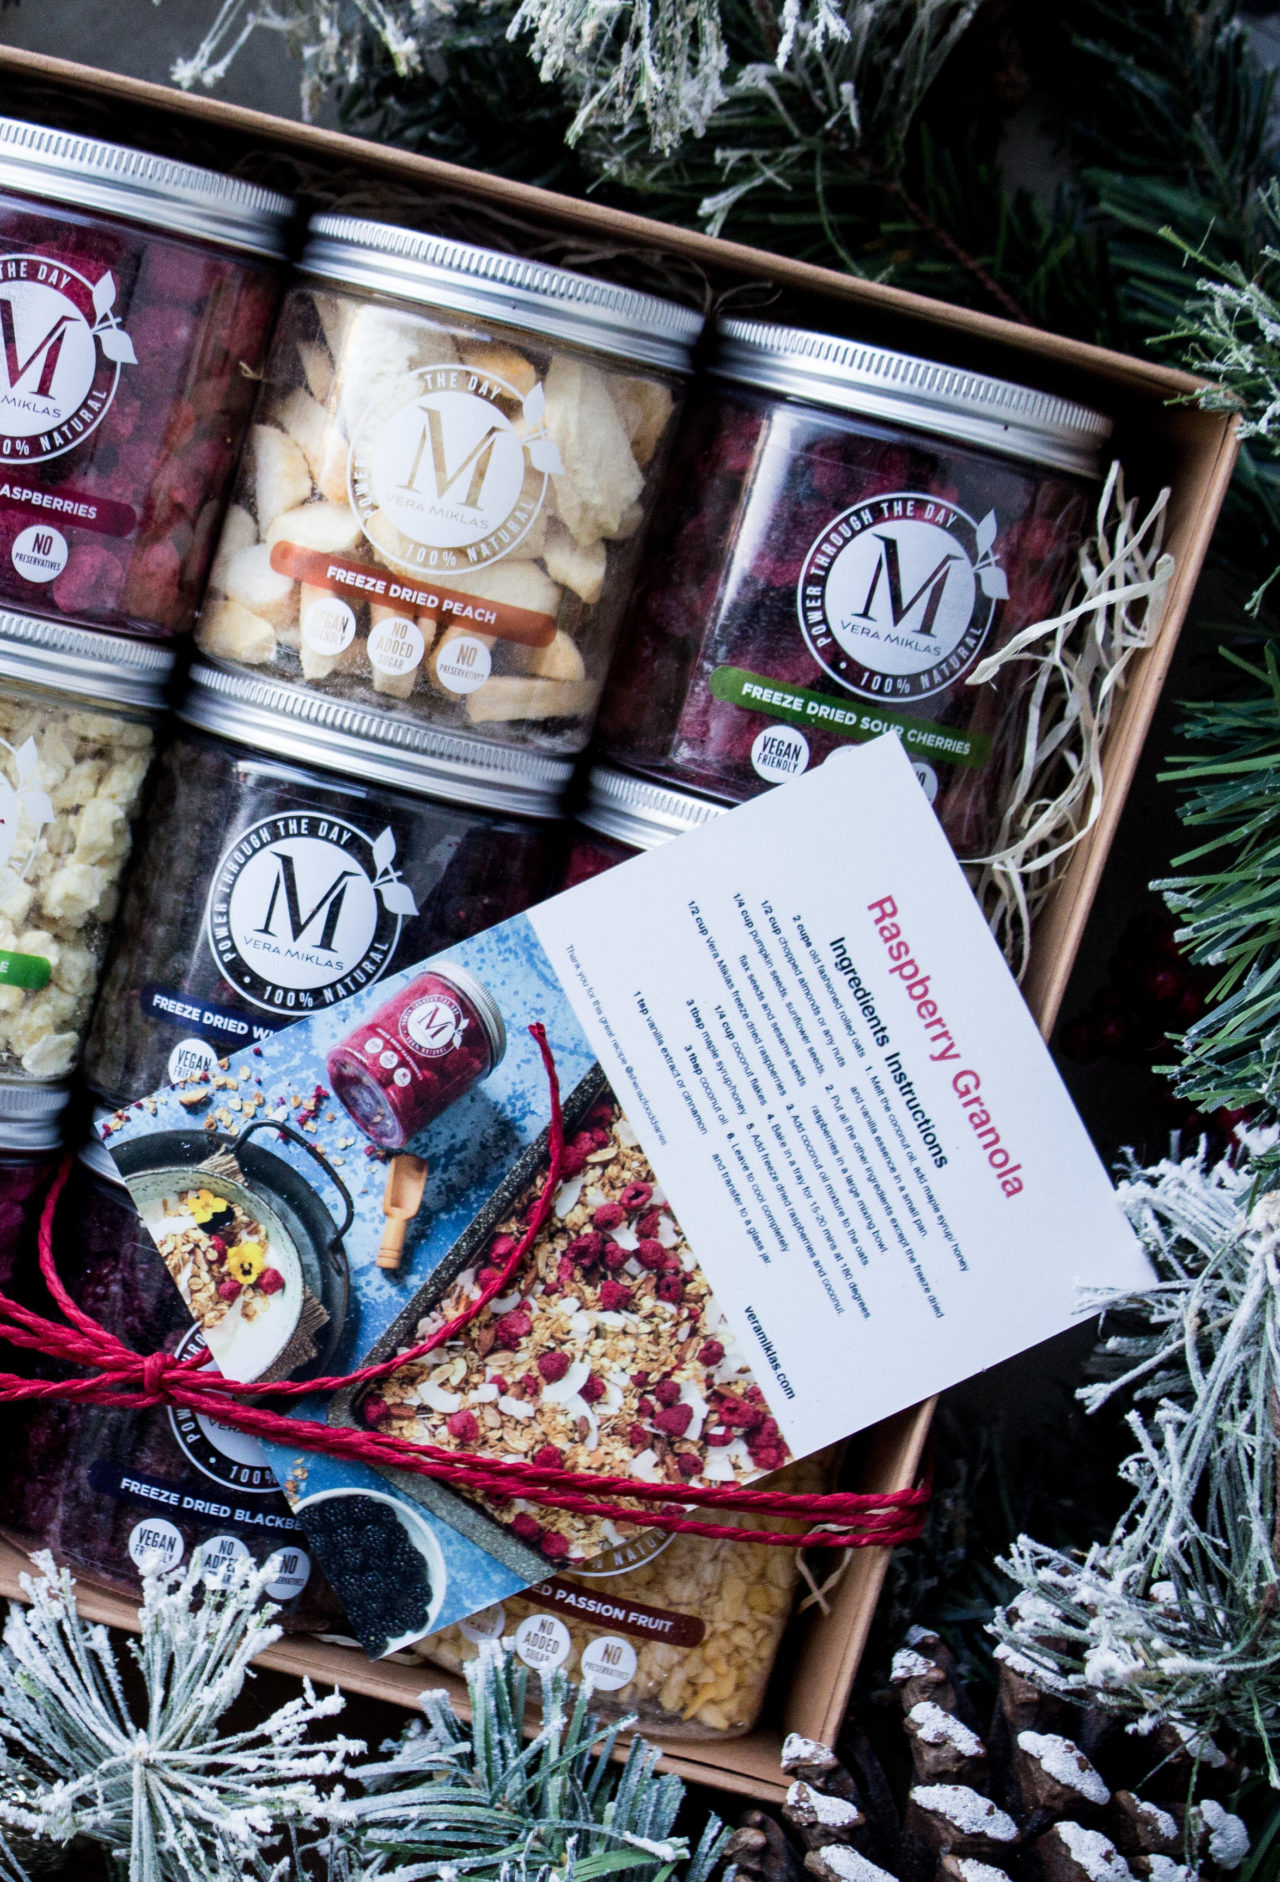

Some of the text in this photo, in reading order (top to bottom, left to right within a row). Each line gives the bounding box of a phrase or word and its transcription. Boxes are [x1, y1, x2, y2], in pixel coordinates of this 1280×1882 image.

[37, 265, 72, 289] DAY
[1, 395, 62, 419] MIKLAS
[424, 372, 502, 400] THE DAY
[40, 390, 107, 452] NATURAL
[396, 405, 510, 512] M
[385, 493, 489, 530] VERA MIKLAS
[406, 501, 534, 567] 100% NATURAL
[15, 553, 61, 571] PRESERVATIVES
[32, 532, 53, 556] NO
[805, 500, 958, 647] POWER THROUGH THE DAY
[326, 565, 498, 625] FREEZE DRIED PEACH
[851, 533, 965, 638] M
[456, 644, 478, 667] NO
[840, 619, 942, 657] VERA MIKLAS
[860, 627, 983, 694] 100% NATURAL
[440, 663, 485, 683] PRESERVATIVES
[741, 682, 805, 712] FREEZE
[806, 701, 857, 726] DRIED
[906, 729, 972, 756] CHERRIES
[761, 735, 802, 762] VEGAN
[757, 753, 800, 775] FRIENDLY
[214, 819, 352, 964] POWER THROUGH THE DAY
[252, 850, 363, 954] M
[243, 935, 345, 972] VERA MIKLAS
[263, 942, 389, 1008] 100% NATURAL
[732, 892, 745, 908] 1/4
[740, 909, 754, 928] cup
[748, 929, 773, 968] pumpkin
[785, 1001, 810, 1044] sunflower
[760, 899, 773, 915] 1/2
[768, 916, 781, 935] cup
[778, 936, 802, 976] chopped
[797, 977, 820, 1016] almonds
[822, 1028, 835, 1045] any
[831, 1046, 845, 1067] nuts
[152, 994, 202, 1022] FREEZE
[202, 1011, 249, 1035] DRIED
[687, 900, 786, 1096] 1/2 cup Vera Miklas freeze dried raspberries
[738, 954, 806, 1086] flax seeds and sesame seeds
[796, 923, 812, 948] cups
[808, 949, 821, 964] old
[816, 964, 843, 1009] fashioned
[838, 1010, 856, 1036] rolled
[851, 1037, 865, 1057] oats
[829, 936, 889, 1047] Ingredients
[178, 1049, 212, 1072] VEGAN
[636, 997, 649, 1015] tsp
[646, 1016, 664, 1046] vanilla
[660, 1046, 680, 1078] extract
[682, 1090, 707, 1134] cinnamon
[689, 1006, 704, 1029] tbsp
[701, 1030, 719, 1059] maple
[715, 1060, 746, 1114] syrup/honey
[714, 1004, 766, 1105] 1/4 cup coconut flakes
[866, 894, 1023, 1198] Raspberry Granola
[688, 1052, 703, 1075] tbsp
[700, 1076, 722, 1112] coconut
[717, 1114, 728, 1124] oil
[884, 1051, 948, 1168] Instructions
[811, 1104, 839, 1155] raspberries
[844, 1174, 860, 1198] large
[856, 1199, 875, 1230] mixing
[744, 1305, 795, 1399] veramiklas.com
[120, 1478, 303, 1531] FREEZE DRIED BLACKBE
[138, 1527, 177, 1553] VEGAN
[219, 1540, 235, 1556] NO
[537, 1619, 554, 1635] NO
[555, 1590, 627, 1621] PASSION
[628, 1611, 674, 1633] FRUIT
[523, 1632, 560, 1655] ADDED
[585, 1661, 631, 1682] PRESERVATIVES
[602, 1642, 622, 1665] NO
